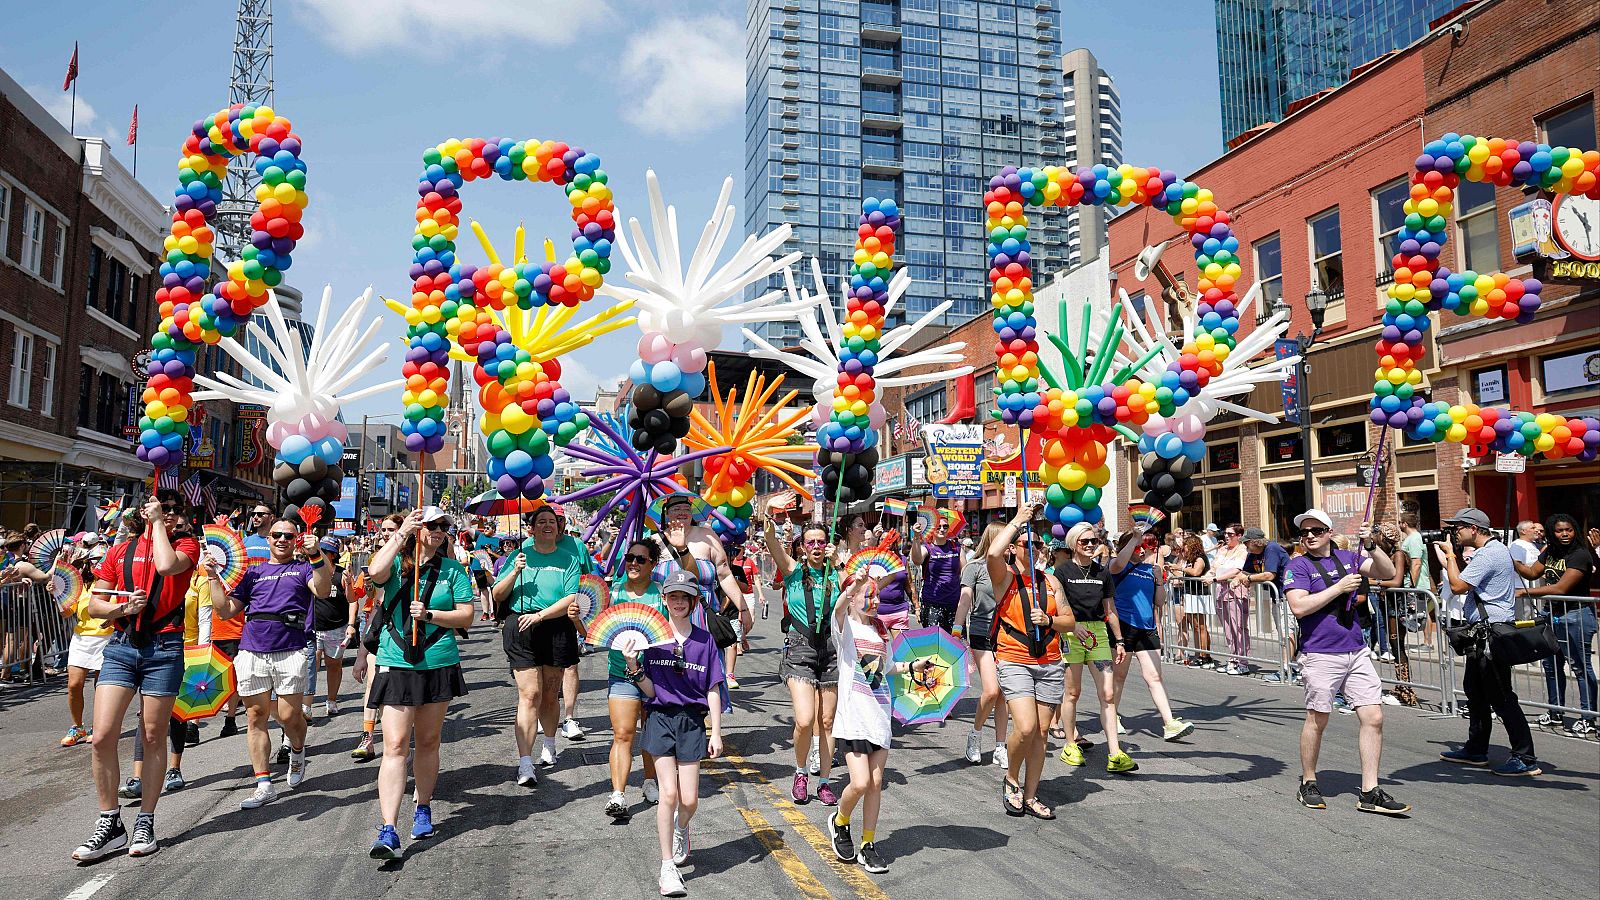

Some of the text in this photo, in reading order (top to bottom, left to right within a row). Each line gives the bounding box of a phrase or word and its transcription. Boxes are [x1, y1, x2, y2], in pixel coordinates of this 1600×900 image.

[1552, 260, 1600, 279] BOO
[242, 419, 252, 461] MUSHROOM
[935, 447, 982, 455] WESTERN
[942, 454, 977, 462] WORLD
[190, 460, 210, 468] BAR
[947, 463, 976, 471] HOME
[1326, 491, 1366, 514] ROOFTOP
[677, 573, 685, 582] B
[660, 659, 706, 673] BRIDSTONE
